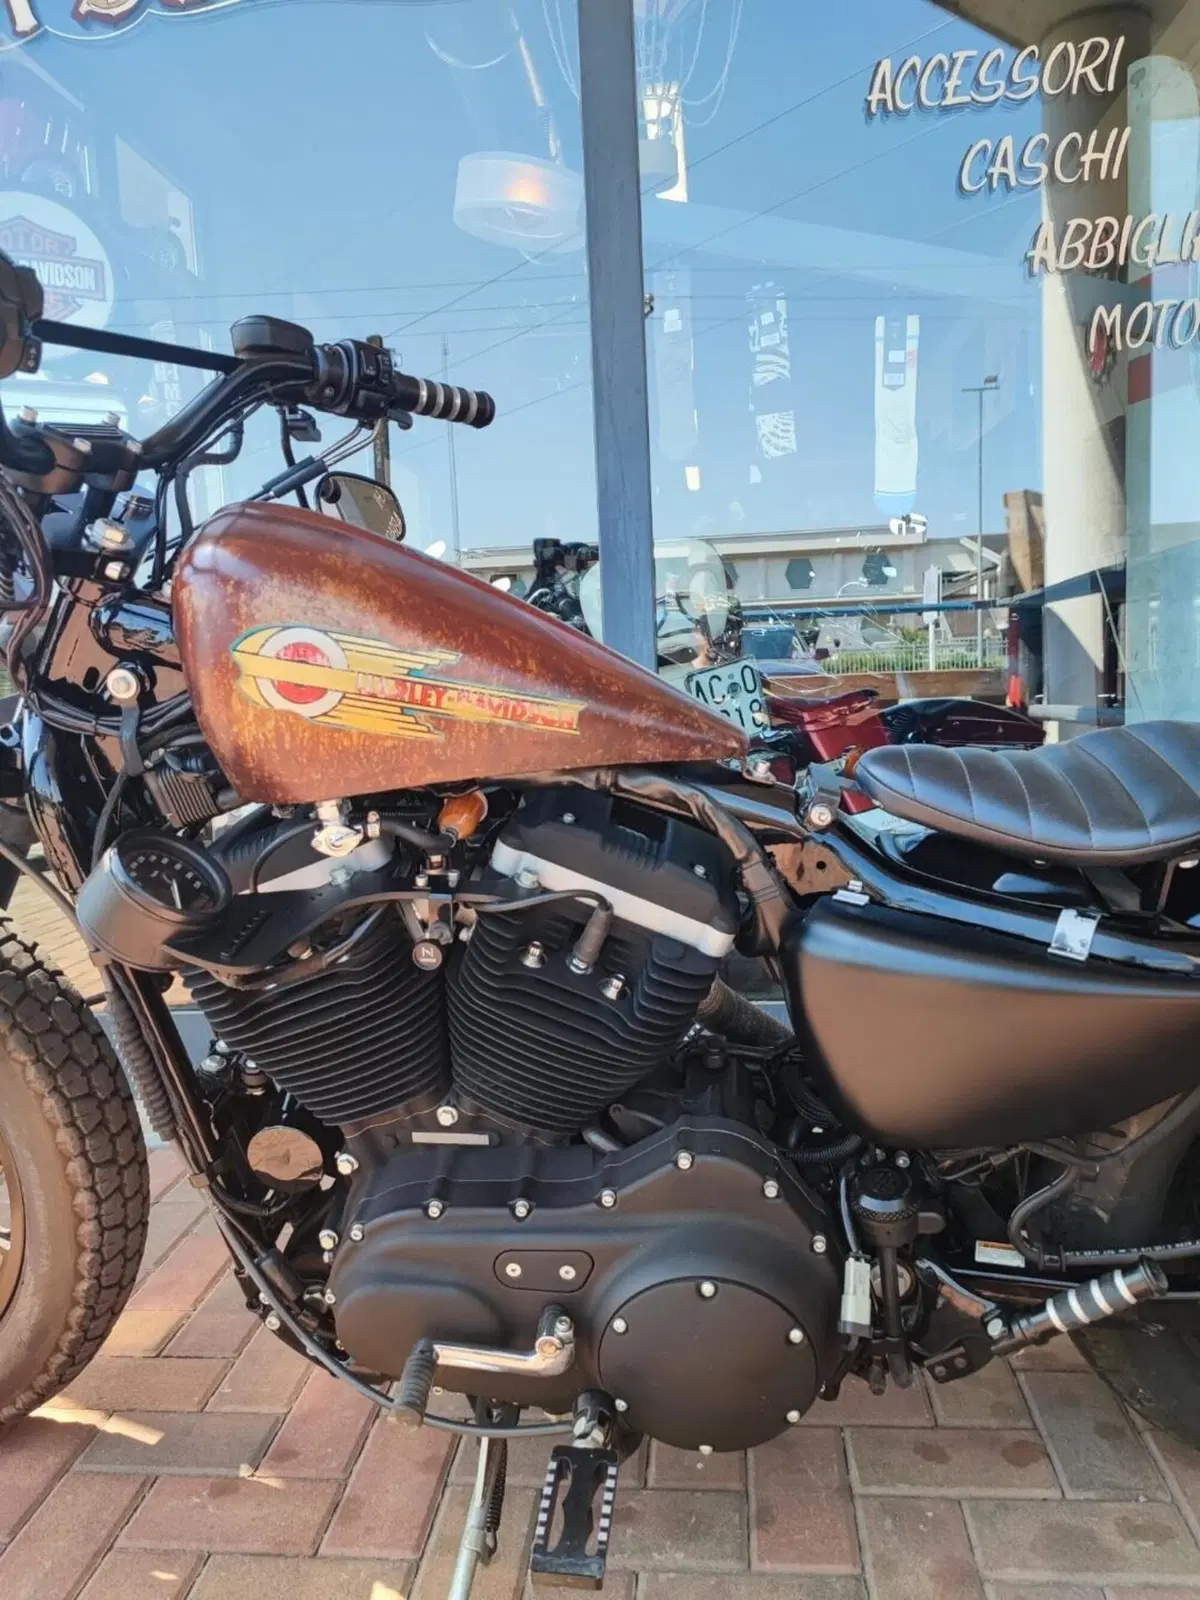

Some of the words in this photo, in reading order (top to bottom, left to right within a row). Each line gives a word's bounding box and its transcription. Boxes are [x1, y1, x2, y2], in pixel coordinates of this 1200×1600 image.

[866, 35, 1126, 115] ACCESSORI
[959, 126, 1132, 193] CASCHI
[19, 259, 96, 291] AVIDSON
[1089, 298, 1200, 353] MOTO
